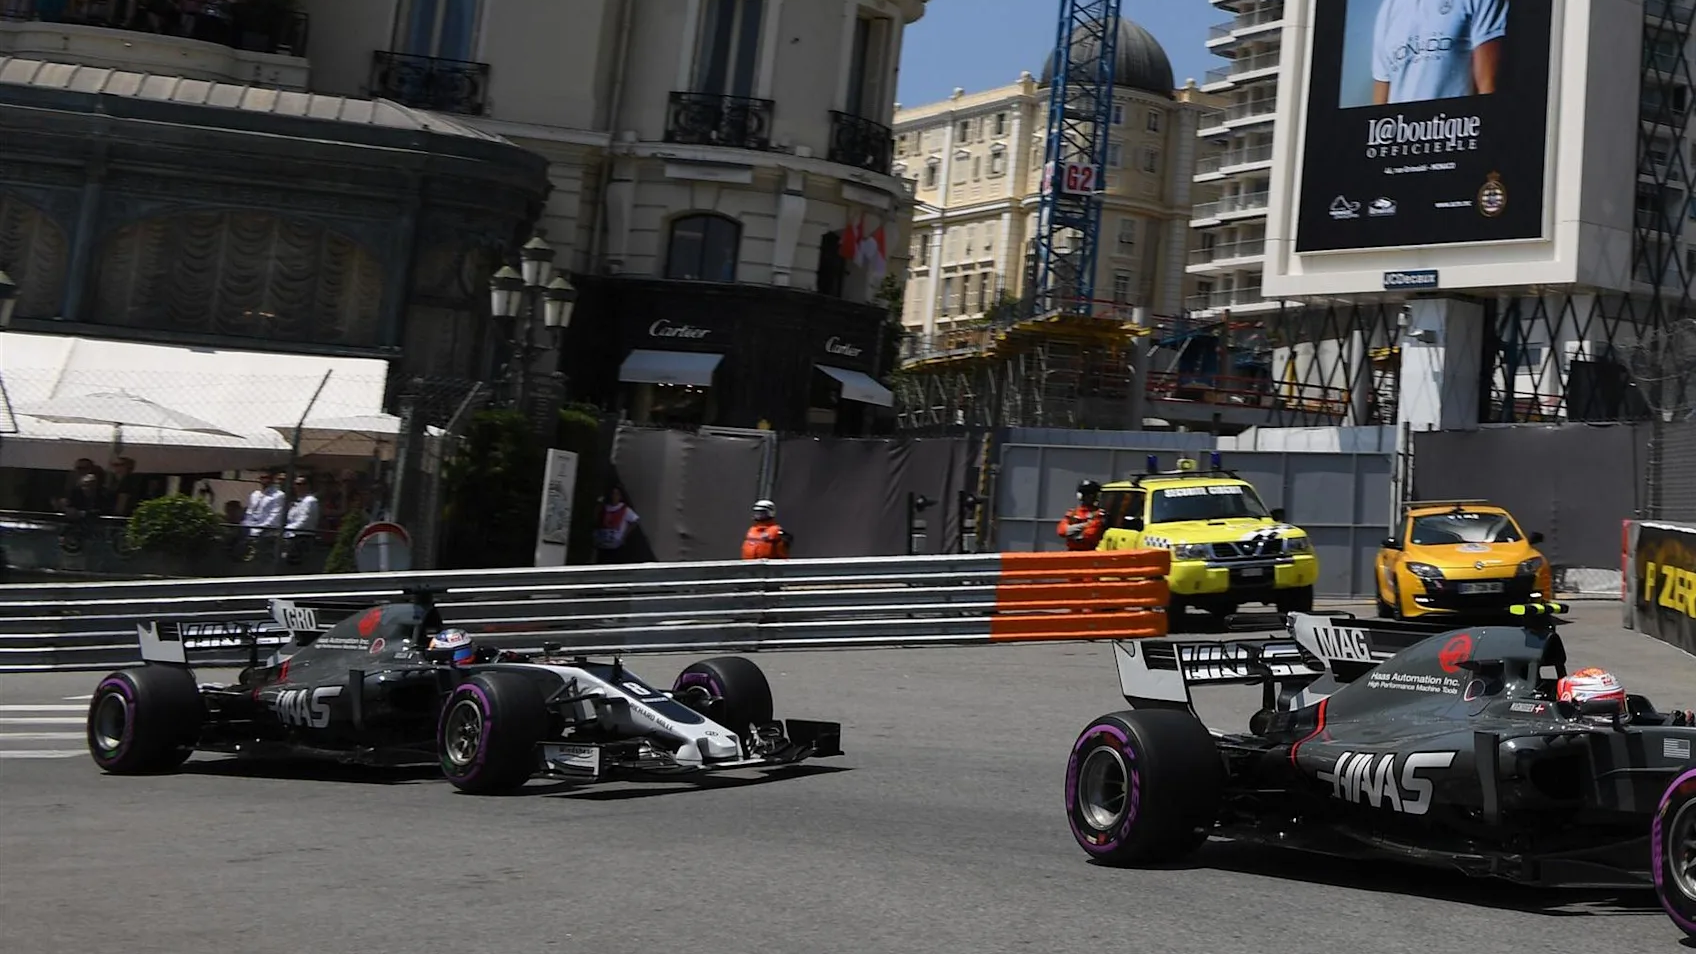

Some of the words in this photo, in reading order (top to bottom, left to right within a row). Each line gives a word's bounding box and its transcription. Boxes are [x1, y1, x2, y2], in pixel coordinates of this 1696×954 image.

[1365, 138, 1478, 159] OFFICIELLE
[1067, 164, 1093, 192] G2
[1384, 272, 1437, 286] JCDecaux
[648, 317, 713, 340] Cartier
[824, 335, 863, 357] Cartier
[1644, 560, 1657, 602] P
[286, 607, 317, 630] GRO
[1317, 626, 1372, 662] MAG
[622, 681, 652, 696] 8
[1371, 671, 1391, 681] Haas
[1391, 672, 1442, 685] Automation
[1443, 677, 1460, 687] Inc.
[268, 685, 344, 729] HAAS
[1317, 750, 1457, 816] HAAS
